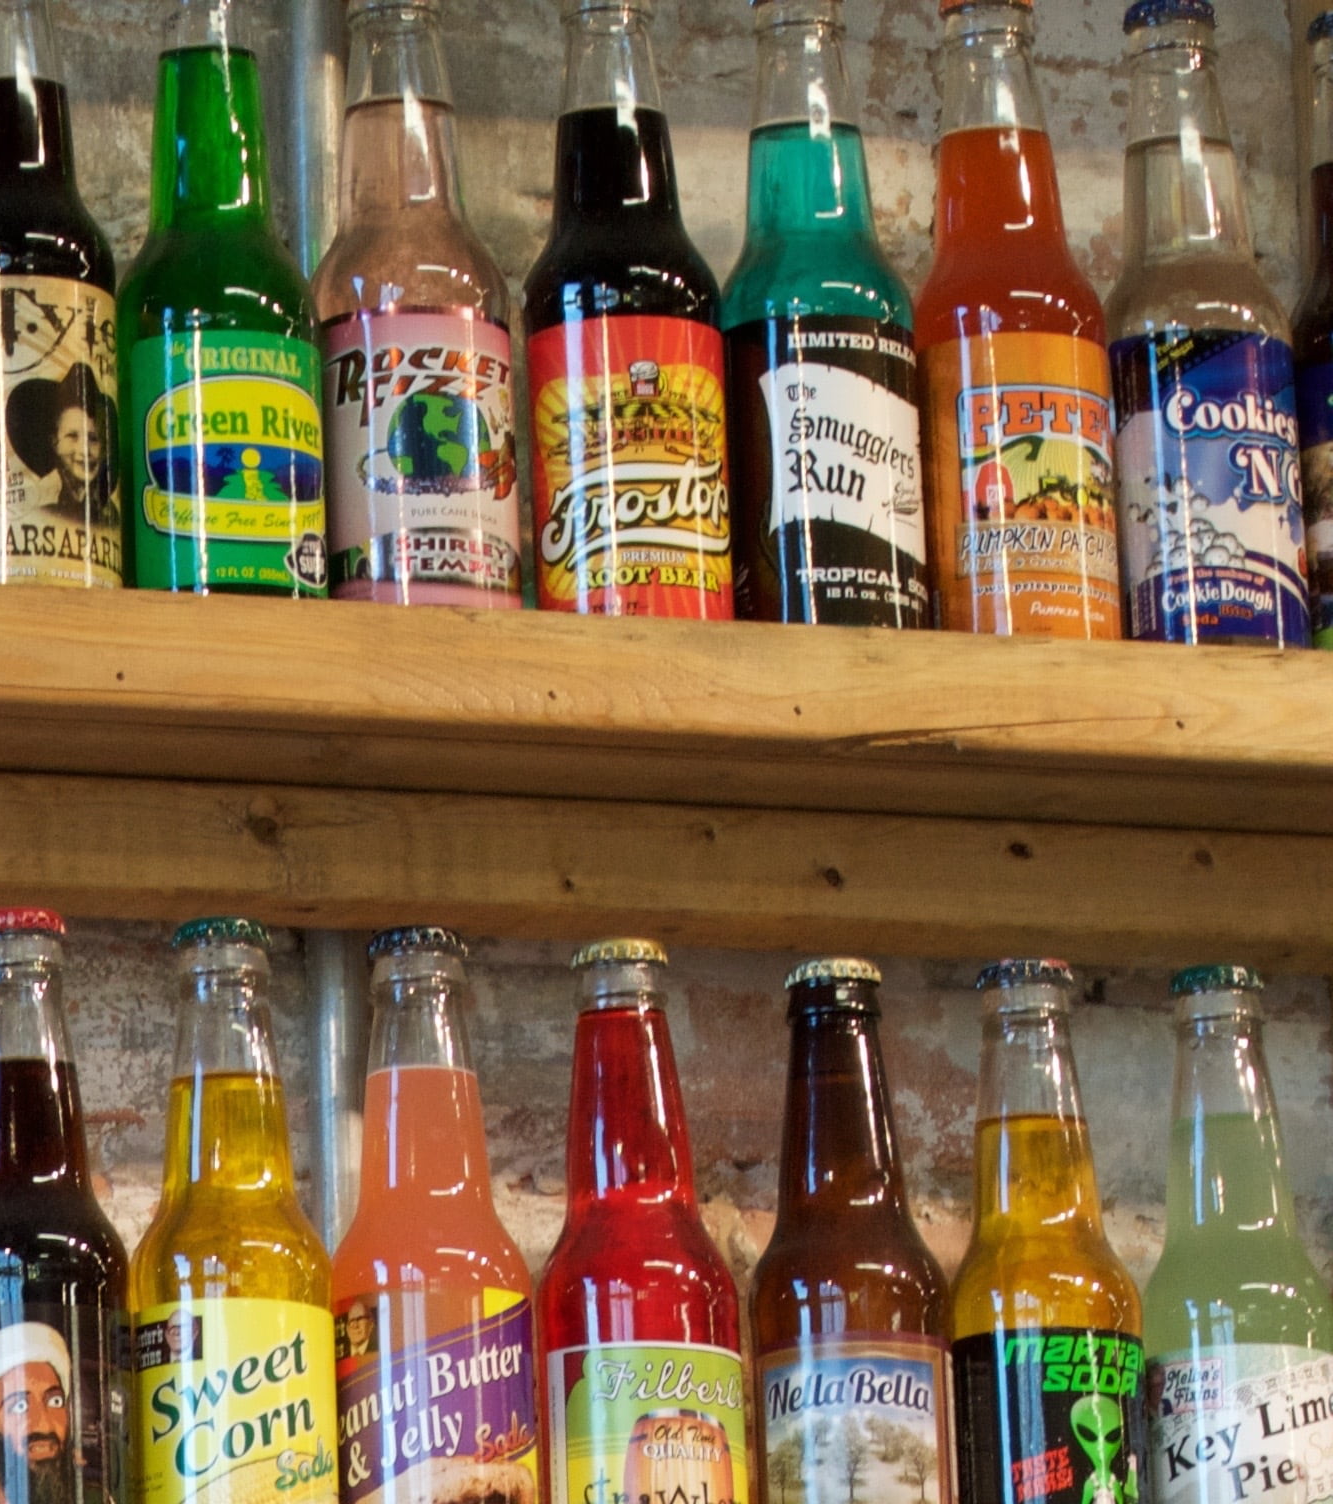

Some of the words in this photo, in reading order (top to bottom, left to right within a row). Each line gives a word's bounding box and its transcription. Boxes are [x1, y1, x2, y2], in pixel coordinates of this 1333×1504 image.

[325, 347, 509, 405] ROCKET
[154, 403, 248, 436] Green
[263, 405, 320, 441] River
[788, 409, 914, 476] Smugglers
[1164, 392, 1298, 445] Cookies
[788, 448, 867, 499] Run
[579, 565, 650, 589] ROOT
[645, 568, 718, 590] BEER
[797, 567, 902, 587] TROPICAL
[150, 1331, 308, 1442] Sweet
[427, 1341, 523, 1396] Butter
[767, 1368, 847, 1417] Nella
[849, 1364, 932, 1413] Bella
[172, 1395, 316, 1478] Corn
[381, 1406, 463, 1481] Jelly
[1165, 1417, 1242, 1478] Key
[1231, 1449, 1298, 1500] Pie
